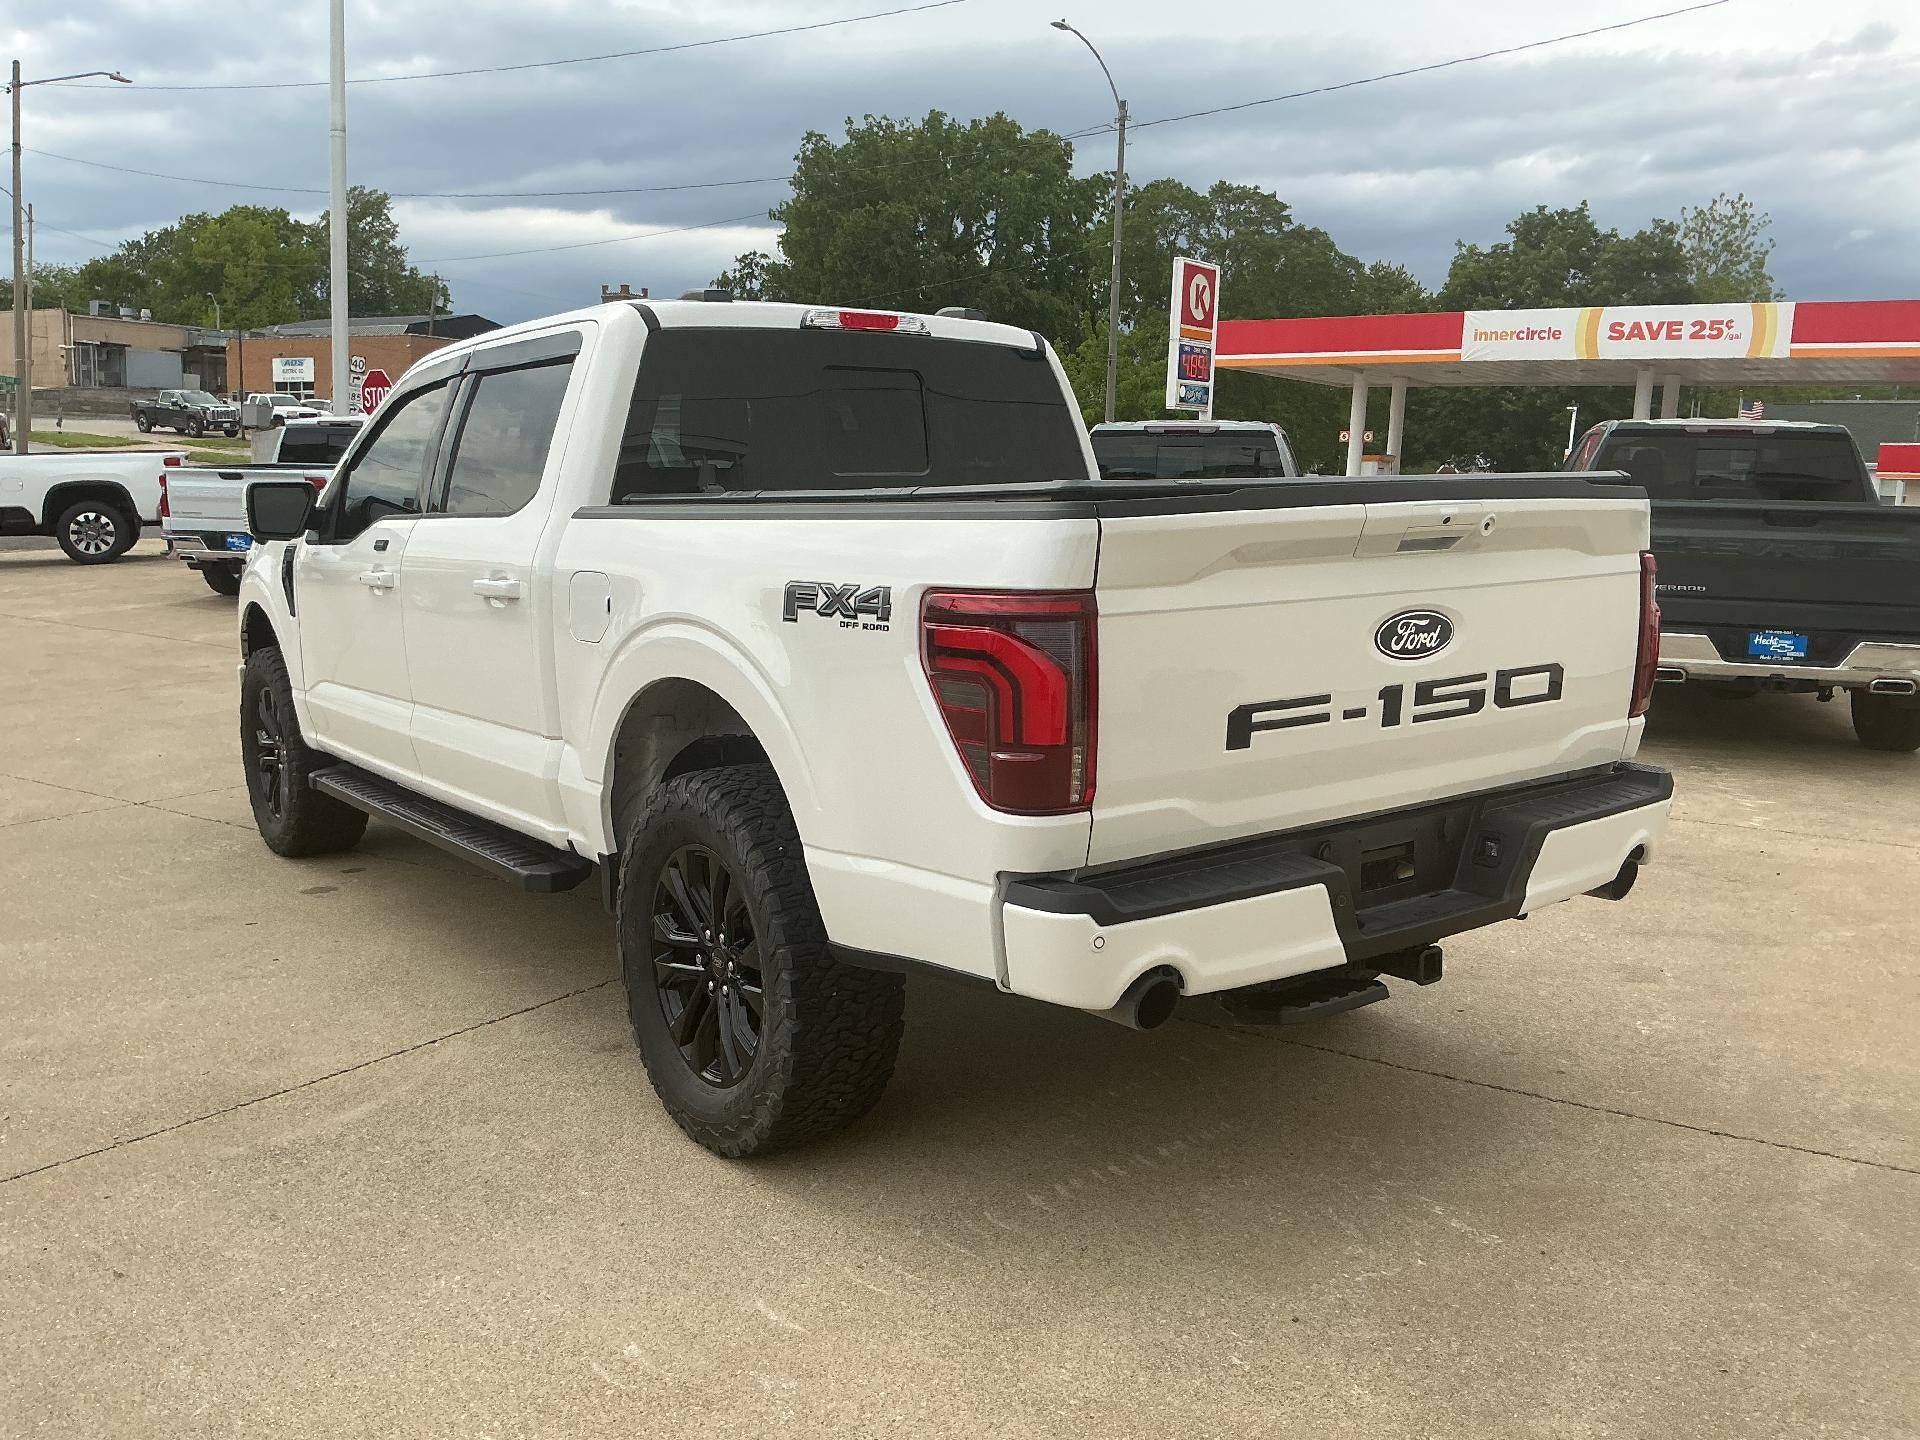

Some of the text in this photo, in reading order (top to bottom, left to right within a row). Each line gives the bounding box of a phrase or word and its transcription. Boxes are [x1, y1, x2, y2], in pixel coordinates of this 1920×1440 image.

[1474, 327, 1562, 341] innercircle
[1607, 321, 1684, 340] SAVE
[352, 359, 365, 370] 40
[783, 580, 892, 622] FX4
[840, 621, 890, 632] OFF ROAD
[1391, 619, 1441, 651] Ford
[1225, 662, 1564, 751] F-150
